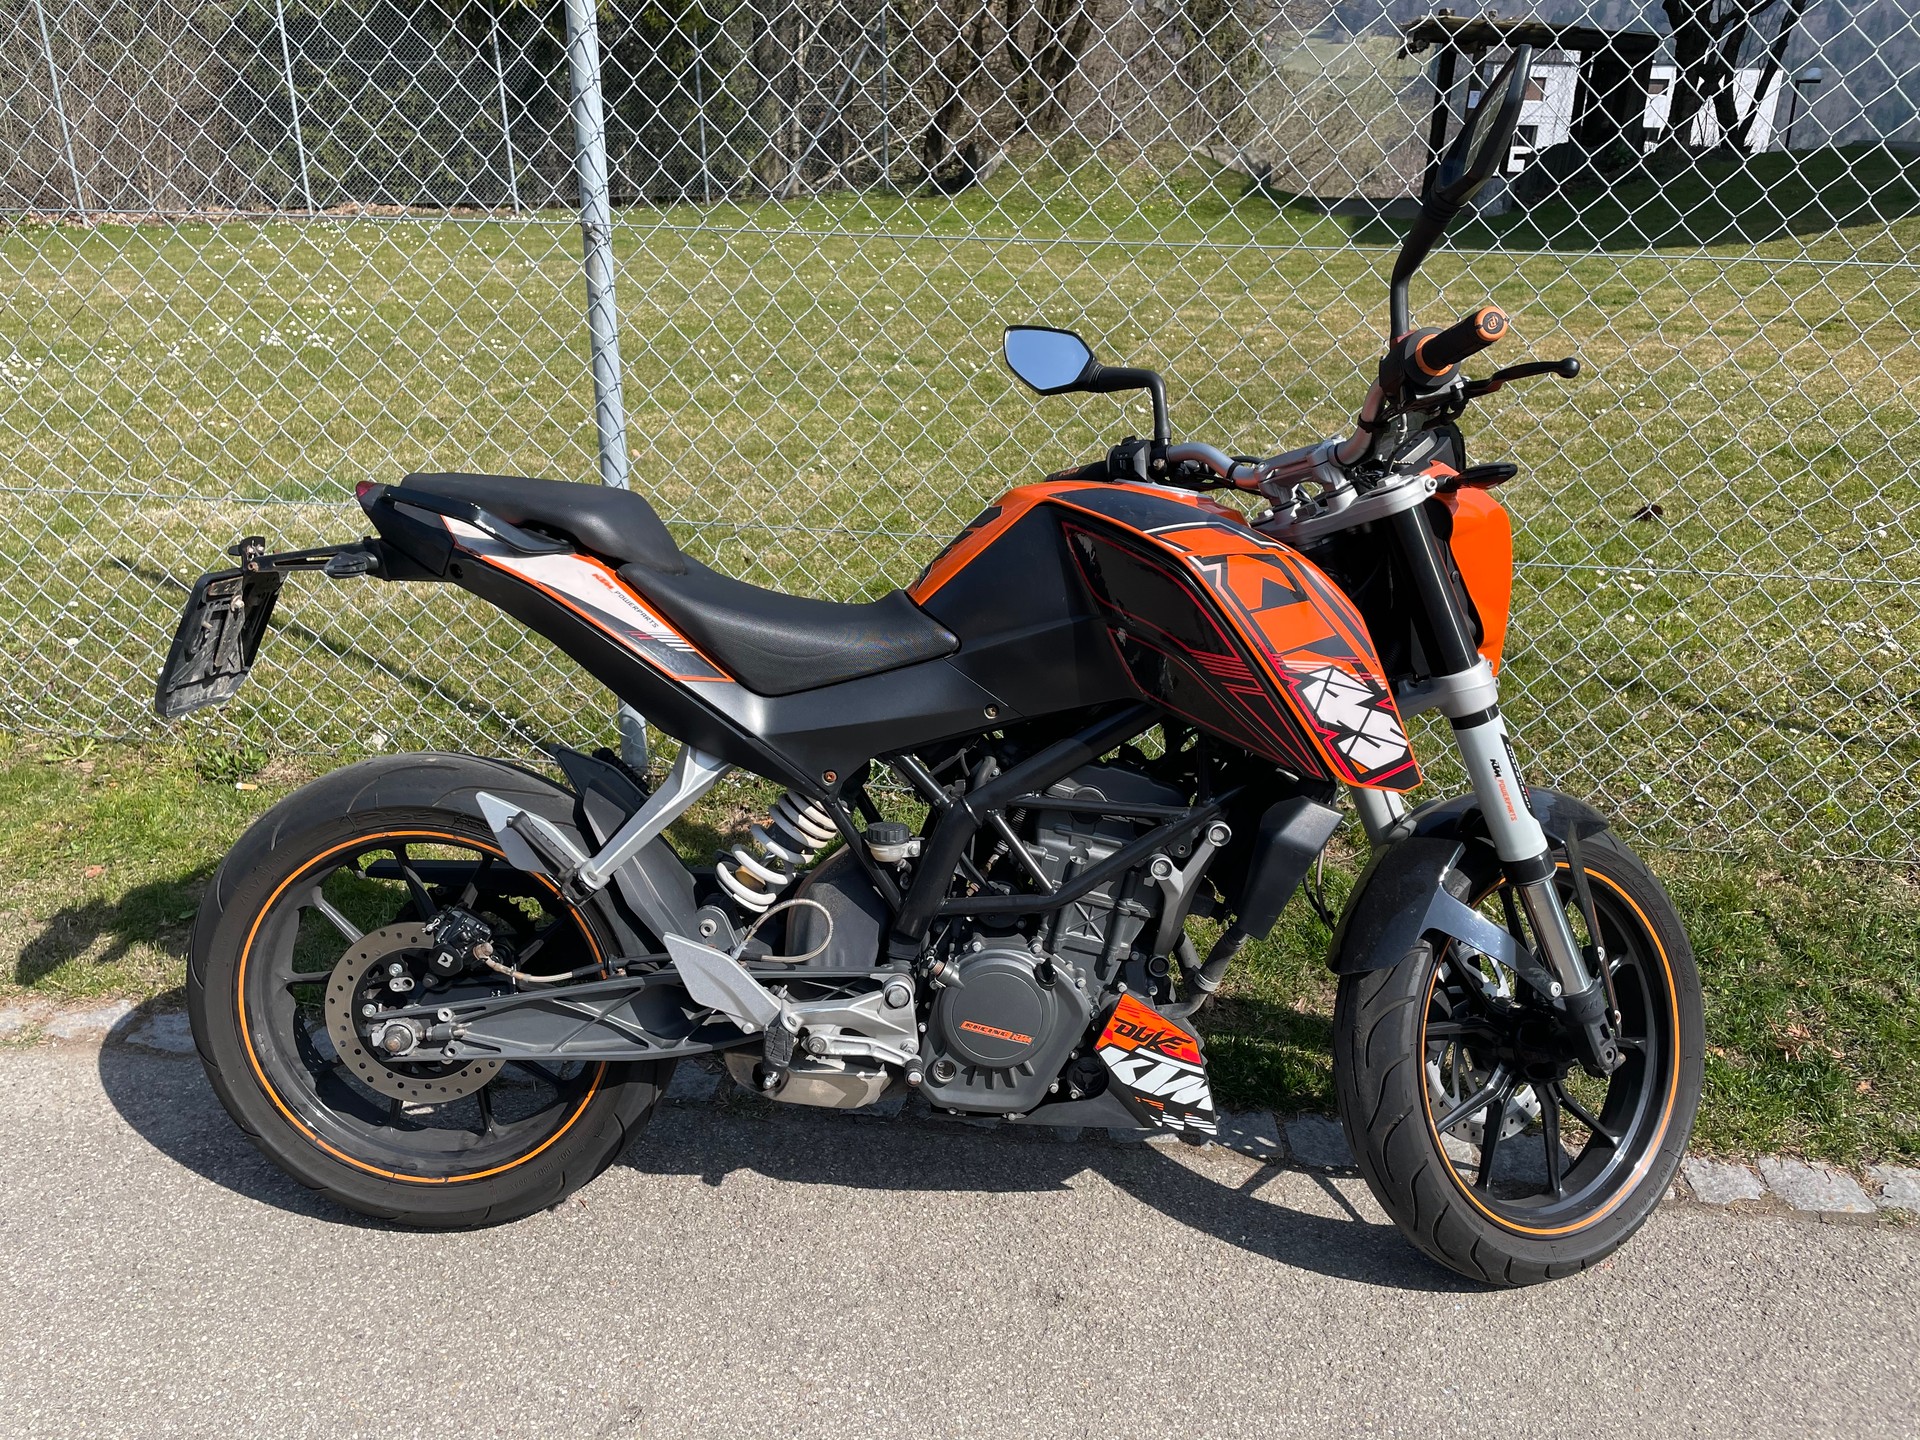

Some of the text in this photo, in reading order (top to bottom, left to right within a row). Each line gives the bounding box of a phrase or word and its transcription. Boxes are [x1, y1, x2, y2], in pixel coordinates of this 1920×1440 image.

[592, 573, 660, 628] KTM POWERPARTS
[1489, 758, 1518, 822] KTM POWERPARTS
[1114, 1016, 1193, 1050] DUKE
[1099, 1045, 1214, 1112] KTM
